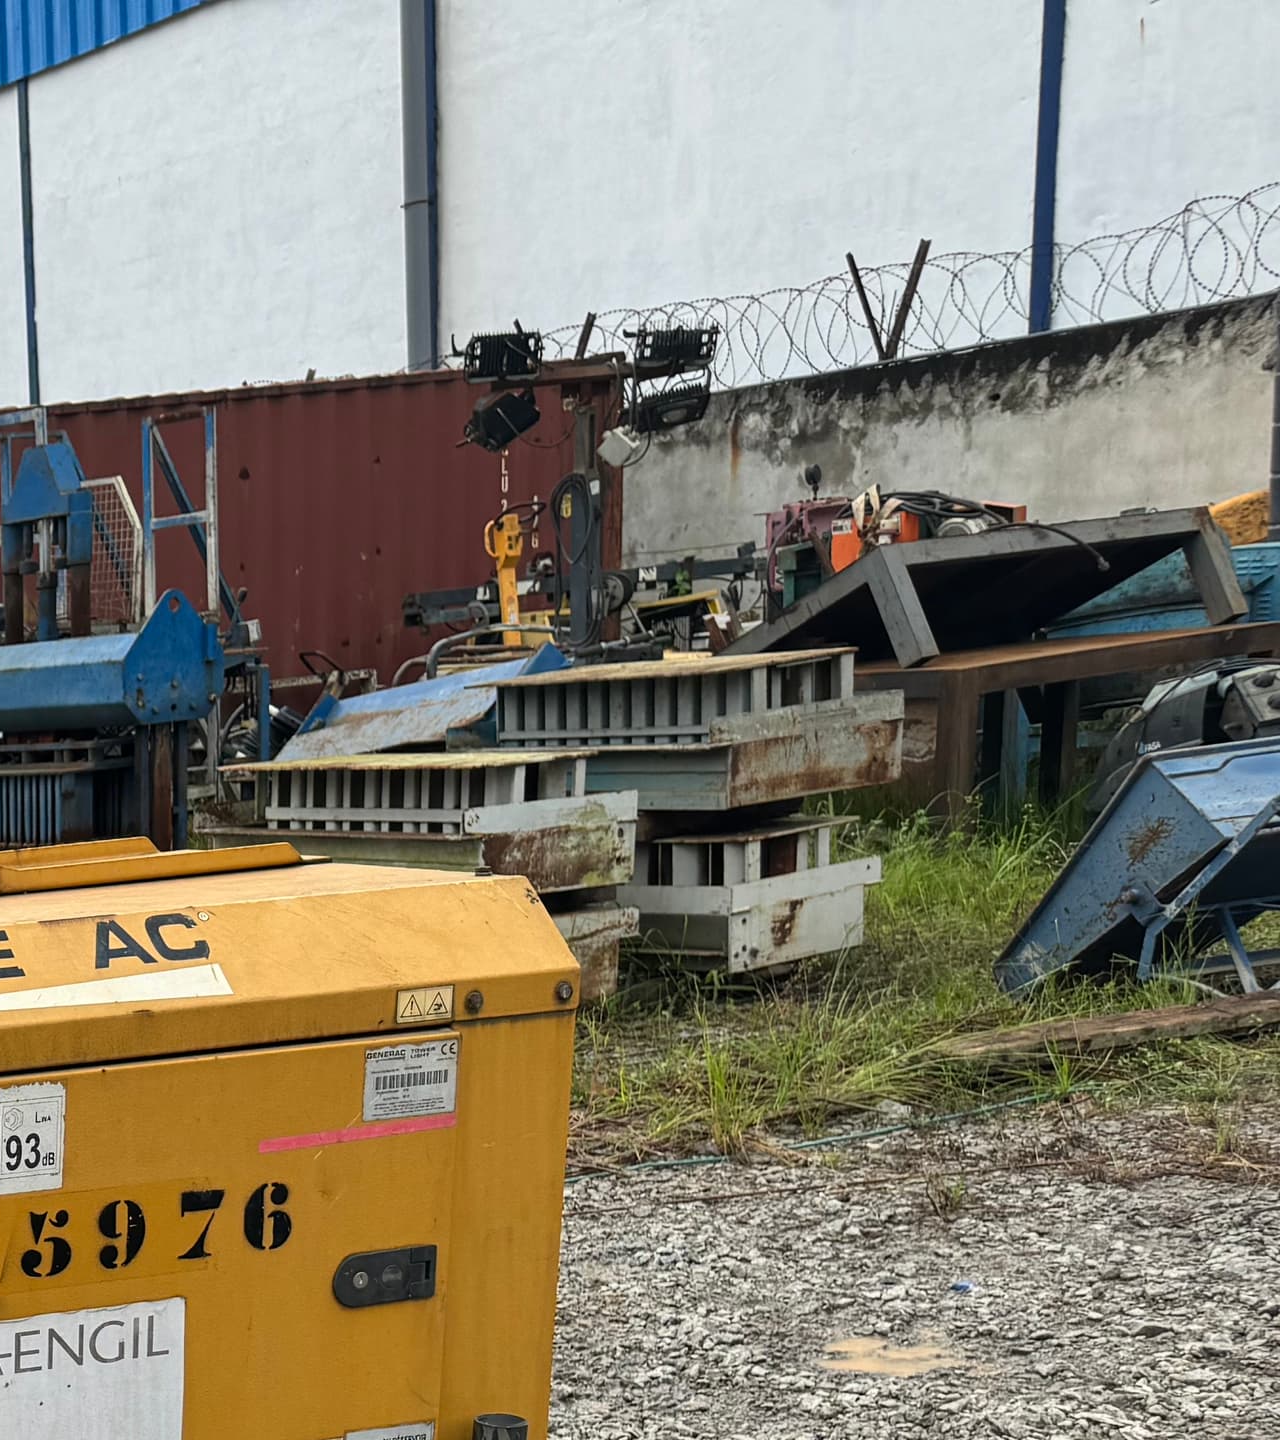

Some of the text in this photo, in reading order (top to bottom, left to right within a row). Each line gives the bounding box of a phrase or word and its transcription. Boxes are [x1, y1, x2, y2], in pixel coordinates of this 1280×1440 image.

[366, 1049, 406, 1060] GENERAC
[6, 1133, 55, 1171] 93 dB
